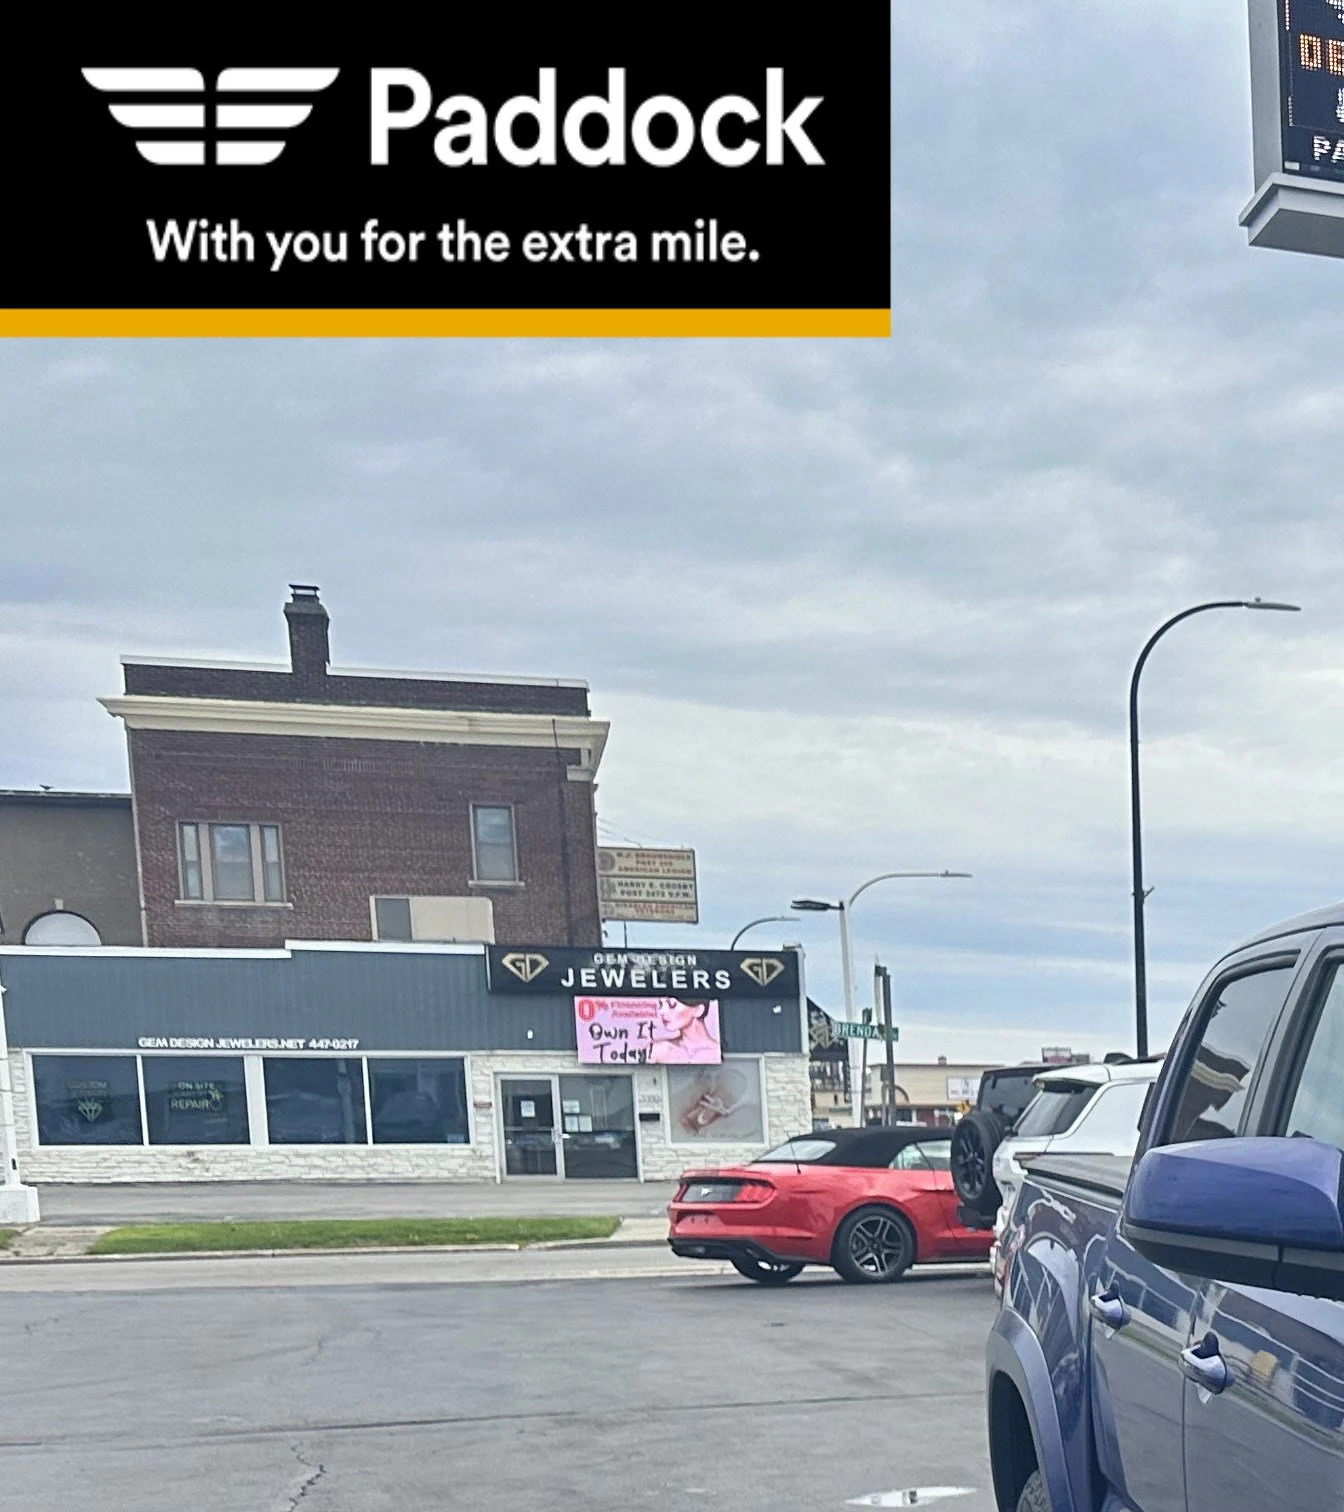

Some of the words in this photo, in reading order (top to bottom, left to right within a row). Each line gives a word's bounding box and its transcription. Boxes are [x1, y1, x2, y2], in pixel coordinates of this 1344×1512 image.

[561, 967, 731, 990] JEWELERS
[589, 1021, 629, 1041] Own
[636, 1020, 657, 1040] It
[138, 1036, 169, 1048] GEM
[169, 1037, 215, 1049] DESIGN
[216, 1037, 306, 1049] JEWELERS.NET
[308, 1037, 360, 1050] 447-0217
[593, 1041, 654, 1064] Today!
[170, 1098, 210, 1111] REPAIR
